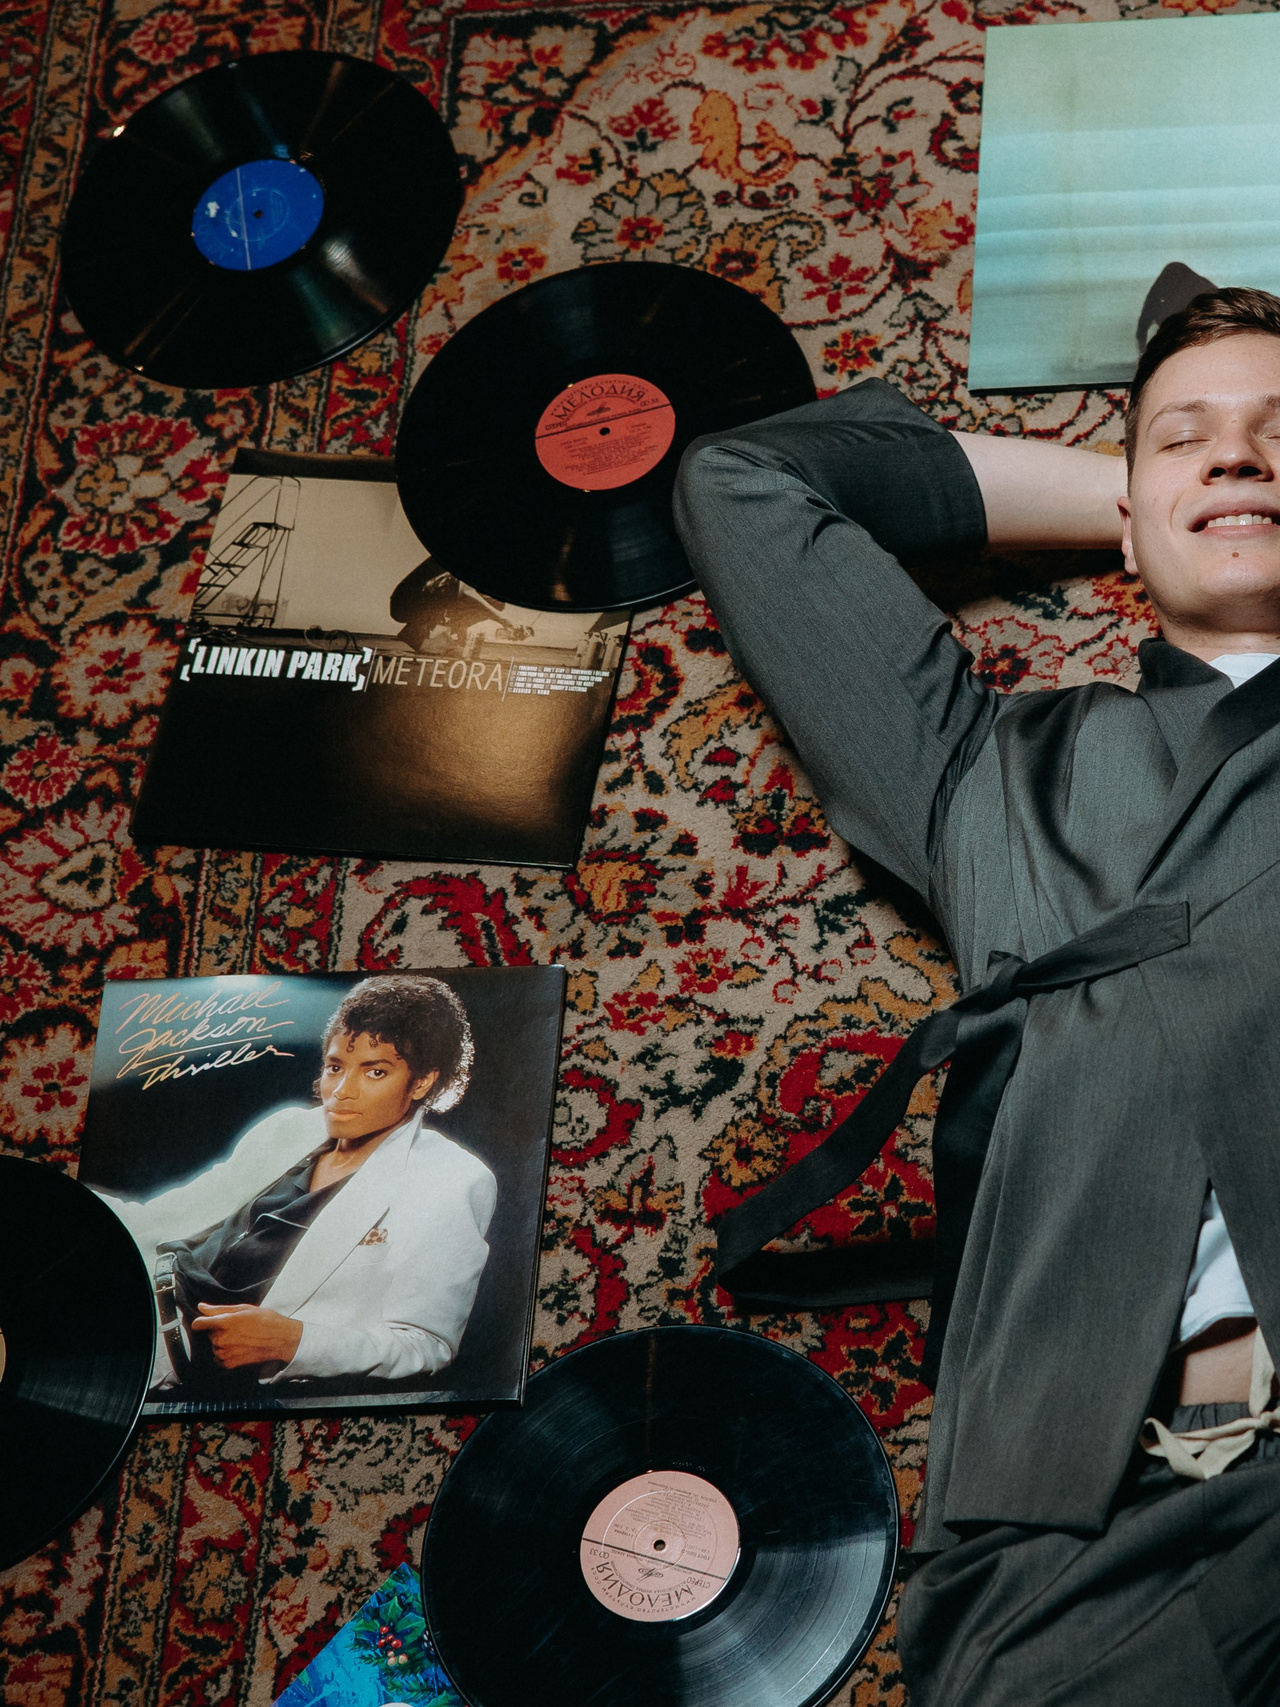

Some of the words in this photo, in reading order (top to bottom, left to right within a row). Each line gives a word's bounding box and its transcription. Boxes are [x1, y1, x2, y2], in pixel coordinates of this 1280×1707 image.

[554, 384, 646, 420] МЕЛОДИЯ
[191, 646, 285, 678] LINKIN
[287, 651, 365, 683] PARK
[372, 656, 504, 691] METEORA
[115, 980, 291, 1035] Michael
[116, 1016, 295, 1079] Jackson
[138, 1042, 296, 1091] Thriller
[589, 1548, 598, 1556] 33
[595, 1561, 694, 1608] МЕЛОДИЯ
[686, 1576, 711, 1589] СТЕРЕО
